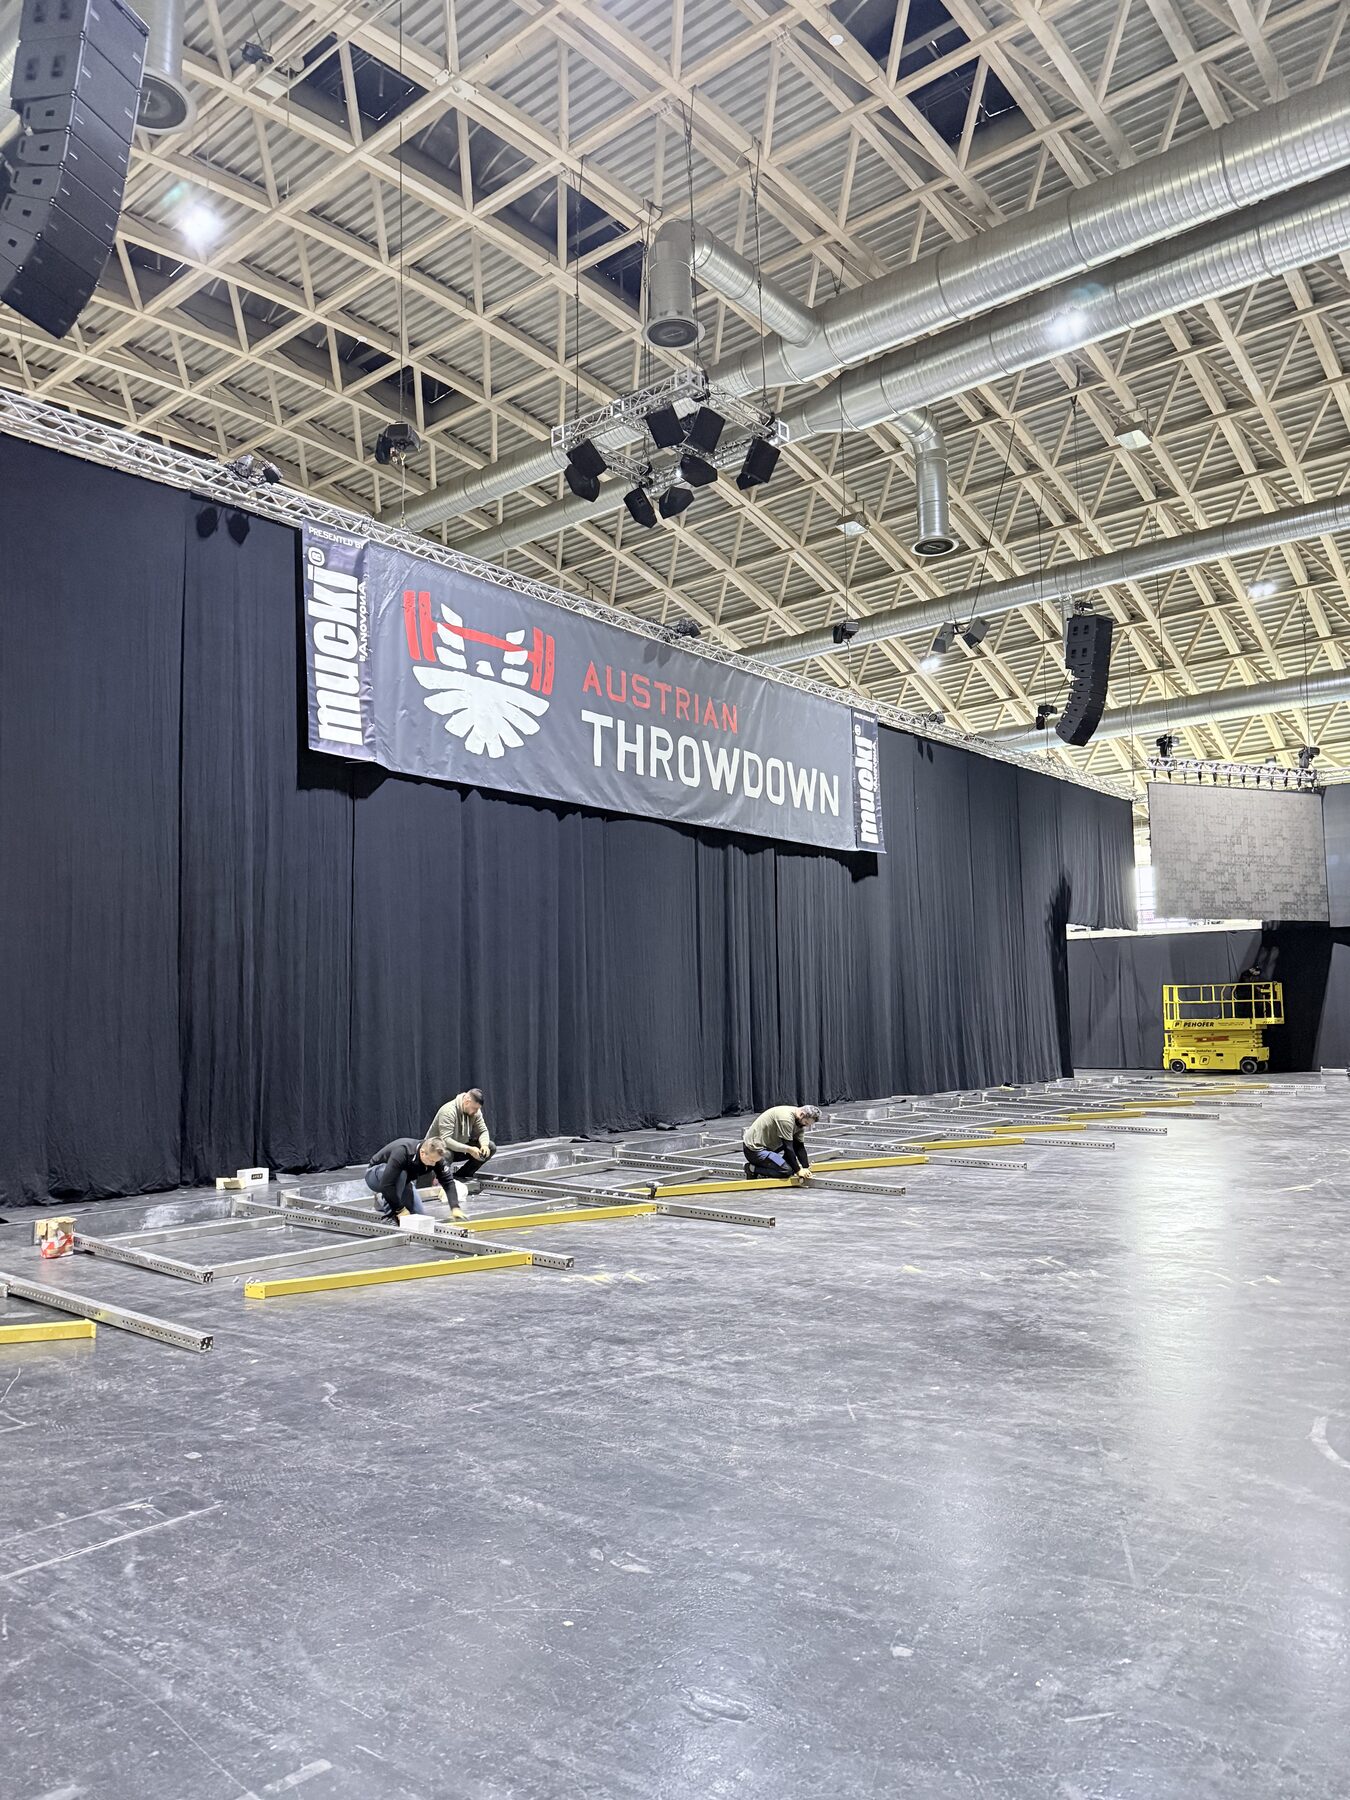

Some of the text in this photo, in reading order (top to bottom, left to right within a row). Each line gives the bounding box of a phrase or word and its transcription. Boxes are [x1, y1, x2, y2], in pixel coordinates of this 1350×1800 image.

[308, 526, 364, 550] PRESENTED BY
[307, 563, 364, 746] mucki
[582, 660, 738, 734] AUSTRIAN
[581, 709, 840, 817] THROWDOWN
